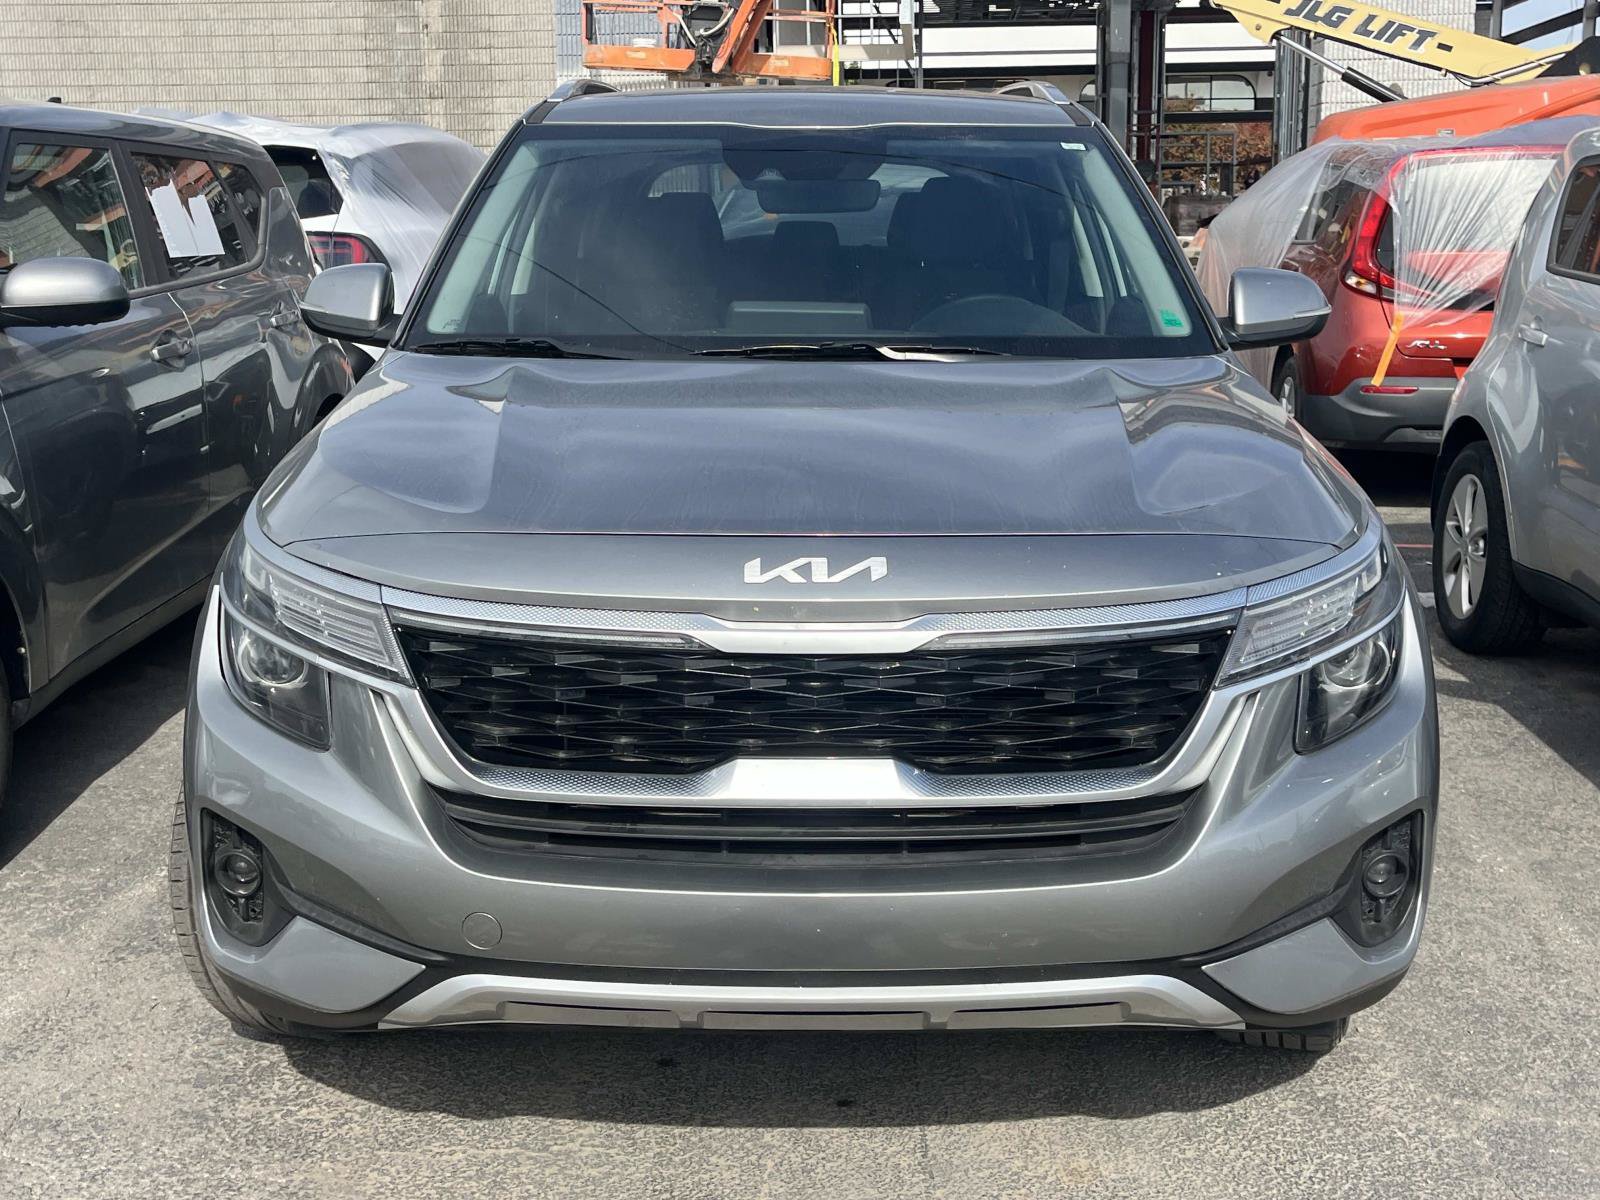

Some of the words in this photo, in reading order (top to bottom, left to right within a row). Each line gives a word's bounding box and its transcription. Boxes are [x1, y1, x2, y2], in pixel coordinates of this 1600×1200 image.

[1283, 0, 1355, 28] JLG
[1353, 14, 1437, 50] LIFT
[744, 557, 888, 583] KIA
